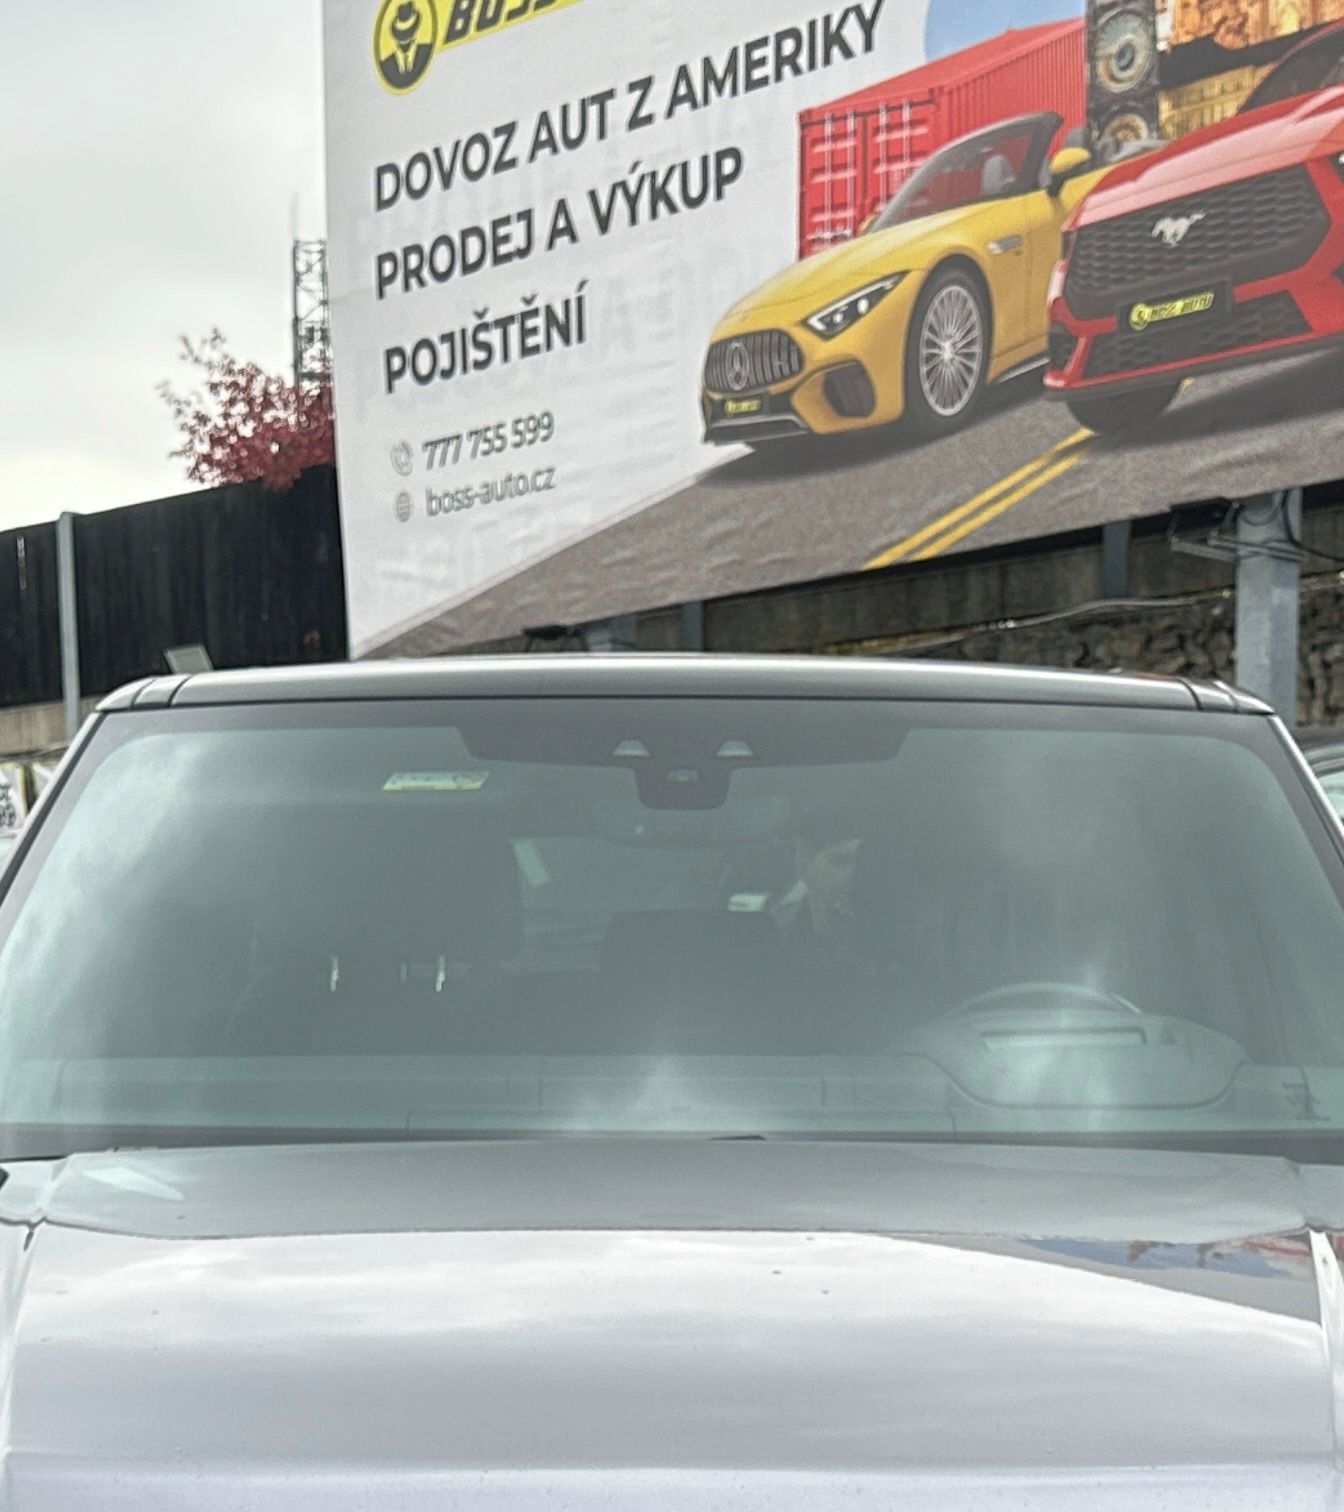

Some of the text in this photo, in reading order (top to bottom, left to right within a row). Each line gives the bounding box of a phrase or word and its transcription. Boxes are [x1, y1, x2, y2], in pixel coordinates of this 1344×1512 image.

[443, 0, 558, 45] BO
[375, 0, 884, 212] DOVOZ AUT Z AMERIKY
[375, 147, 744, 300] PRODEJ A VÝKUP
[385, 279, 589, 394] POJIŠTĚNÍ
[422, 411, 555, 470] 777 755 599
[425, 468, 556, 517] boss-auto.cz
